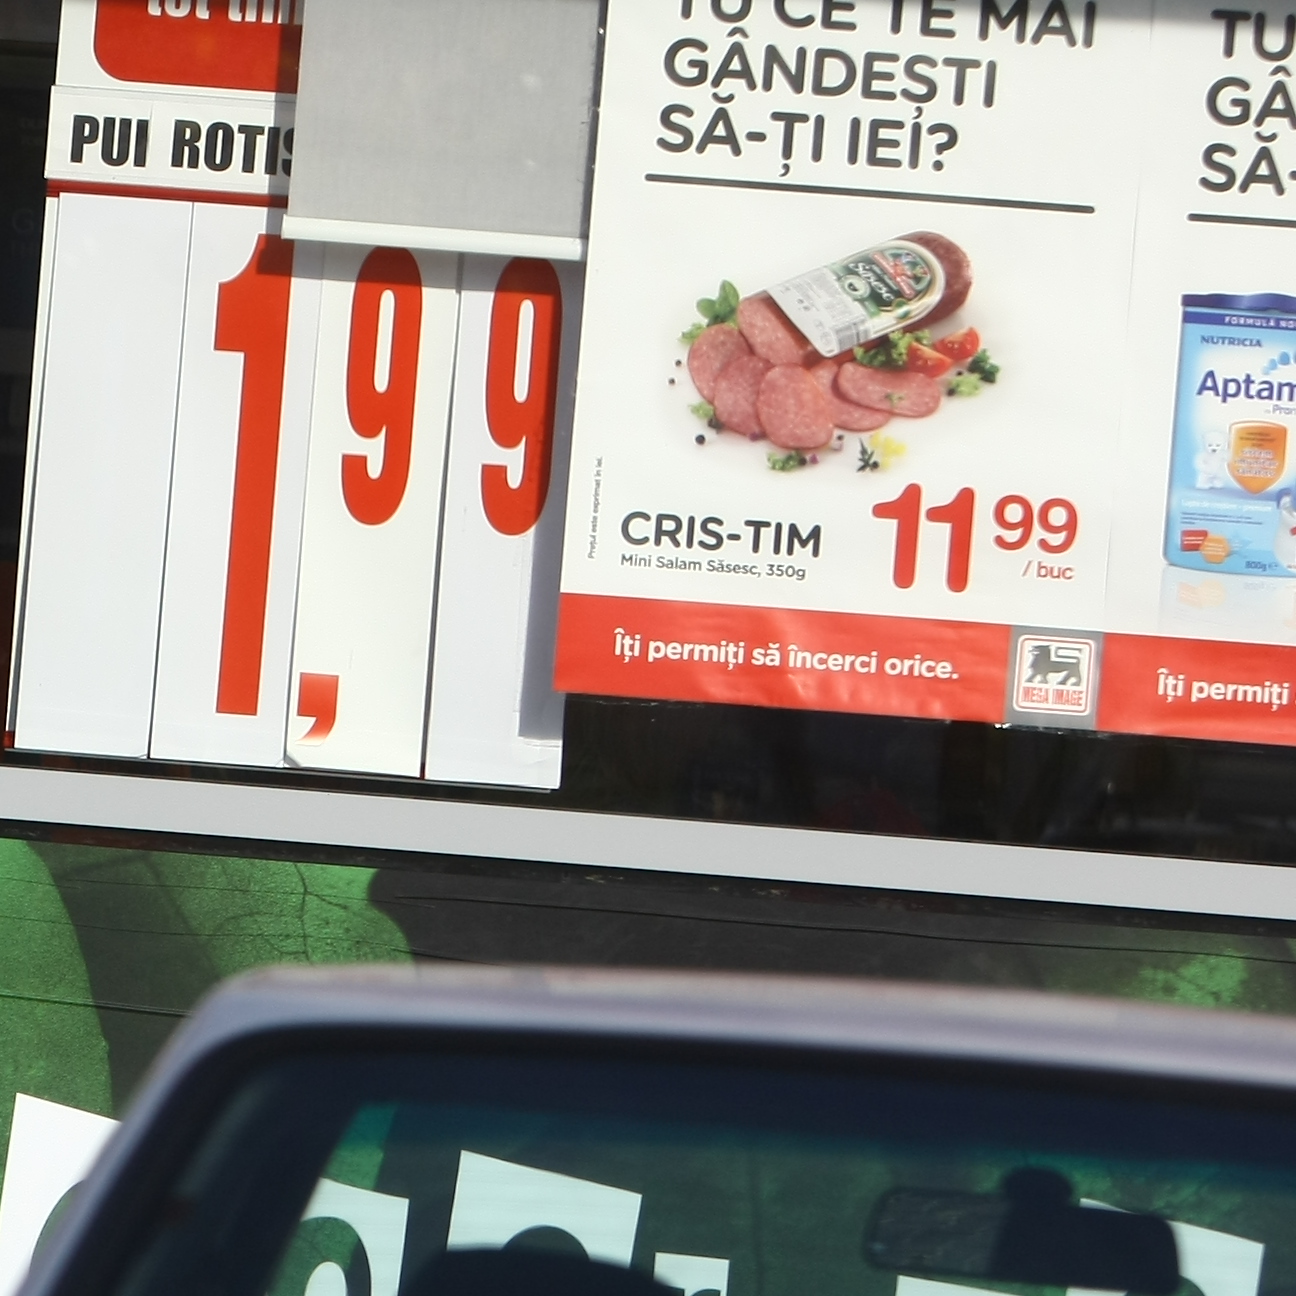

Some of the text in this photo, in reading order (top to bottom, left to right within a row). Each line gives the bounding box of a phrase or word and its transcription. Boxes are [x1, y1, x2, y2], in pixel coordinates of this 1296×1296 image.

[978, 0, 1096, 49] MAI
[662, 27, 998, 118] GÂNDEȘTI
[70, 115, 150, 167] PUI
[655, 92, 960, 178] SĂ-ȚI IEI?
[1200, 335, 1263, 348] NUTRICIA
[621, 511, 822, 558] CRIS-TIM
[620, 553, 807, 581] Mini Salam Săsesc, 350g
[1036, 561, 1075, 580] buc
[614, 627, 959, 680] Îți permiți să încerci orice.
[1021, 685, 1086, 707] MEGA IMAGE
[1157, 667, 1290, 712] Îți permiți
